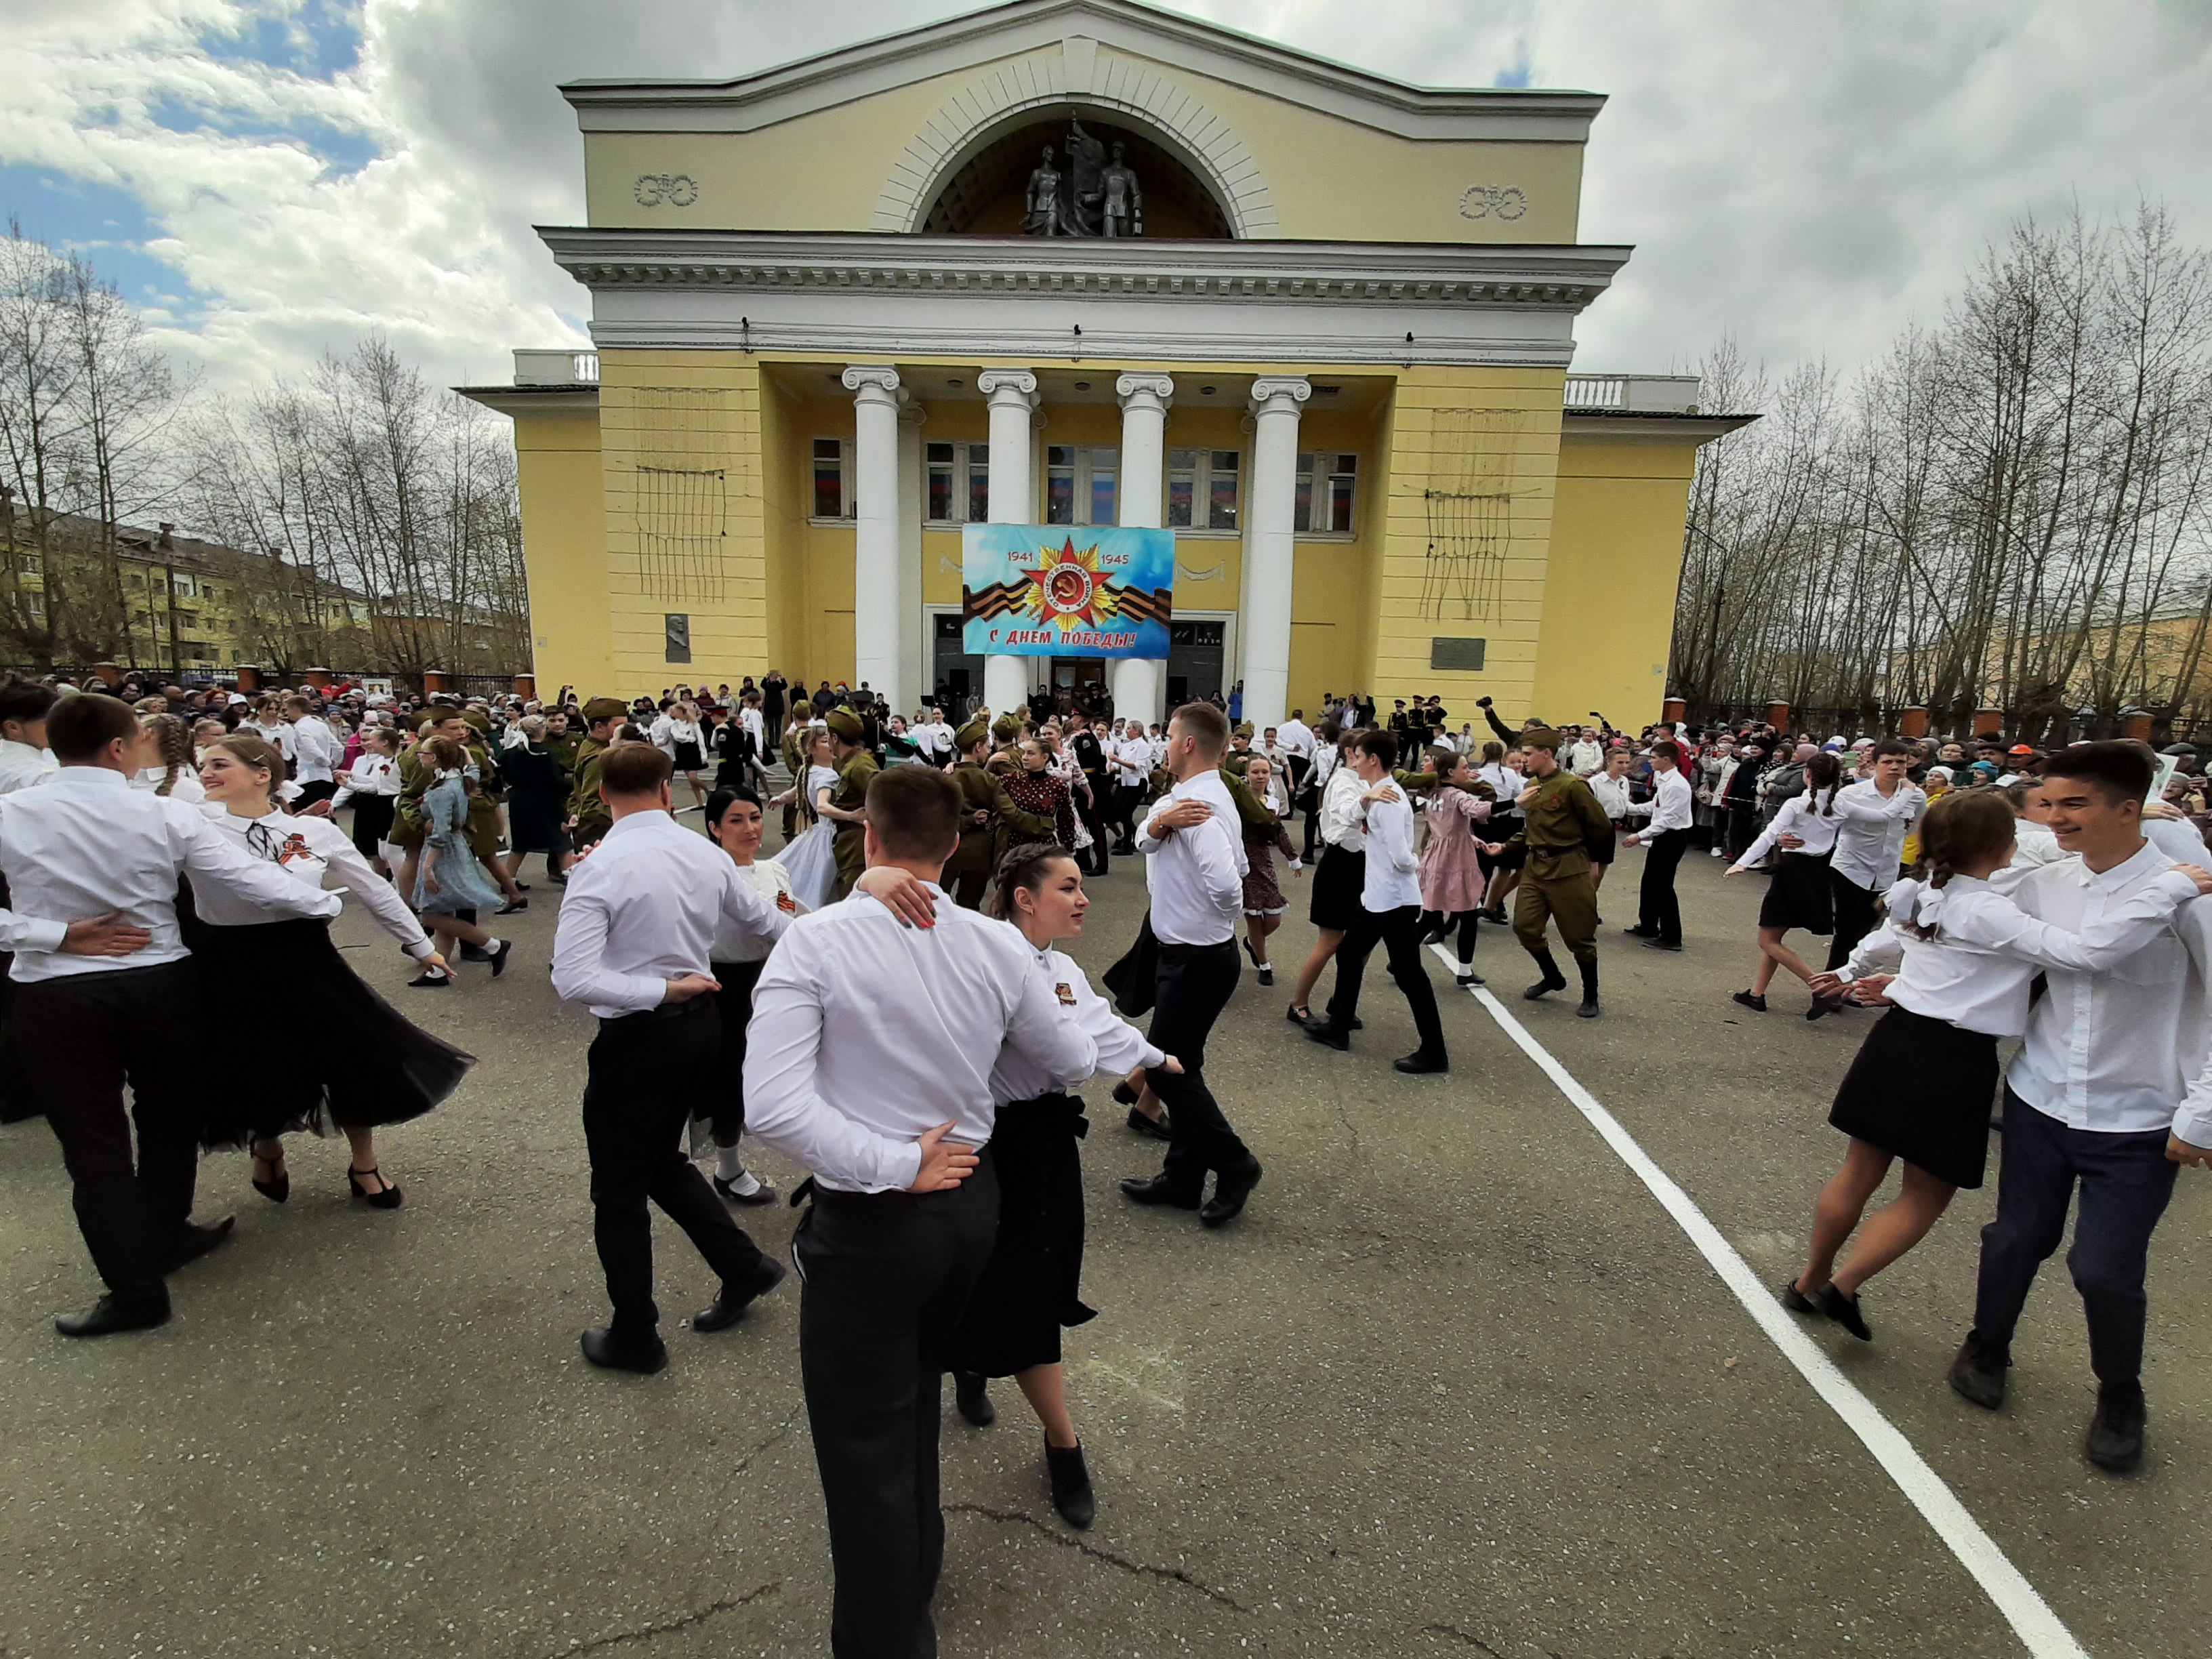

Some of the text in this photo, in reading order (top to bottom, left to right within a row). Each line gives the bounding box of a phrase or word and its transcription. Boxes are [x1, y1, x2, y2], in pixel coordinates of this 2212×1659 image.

[1008, 552, 1033, 562] 1941
[1101, 554, 1129, 565] 1945
[1046, 565, 1087, 607] ОТЕЧЕСТВЕННАЯ
[989, 629, 1136, 649] С ДНЕМ ПОБЕДЫ!
